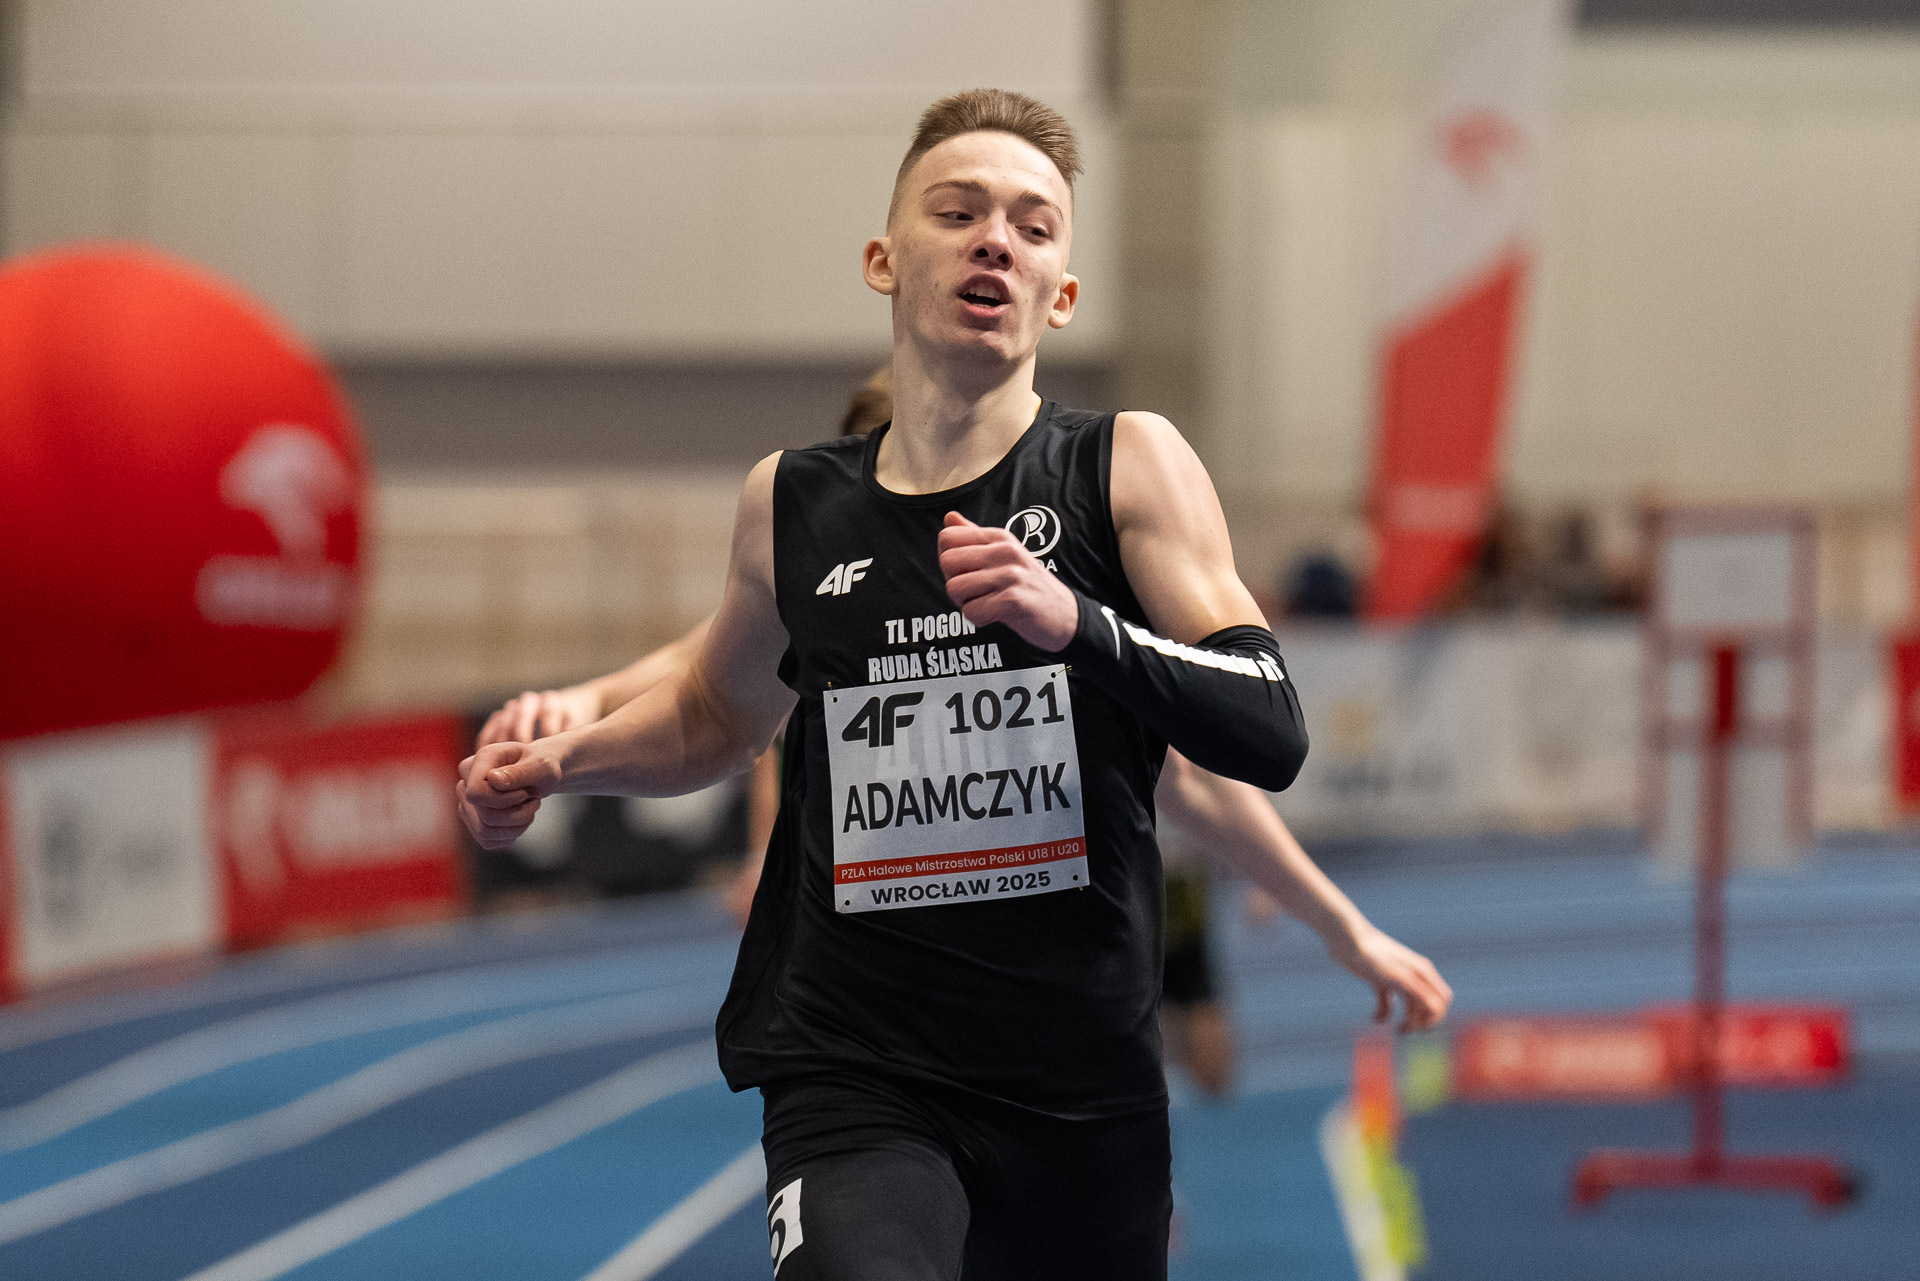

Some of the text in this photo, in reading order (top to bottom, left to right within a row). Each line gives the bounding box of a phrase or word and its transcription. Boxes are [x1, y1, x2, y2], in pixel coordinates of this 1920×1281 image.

[815, 557, 873, 596] 4F
[885, 618, 908, 645] TL
[868, 643, 1003, 683] RUDA ŚLĄSKA
[841, 682, 1065, 748] 4F 1021
[843, 762, 1071, 833] ADAMCZYK
[841, 842, 1080, 880] PZLA Halowe Mistrzostwa Polski U18 i U20
[870, 870, 1051, 905] WROCŁAW 2025
